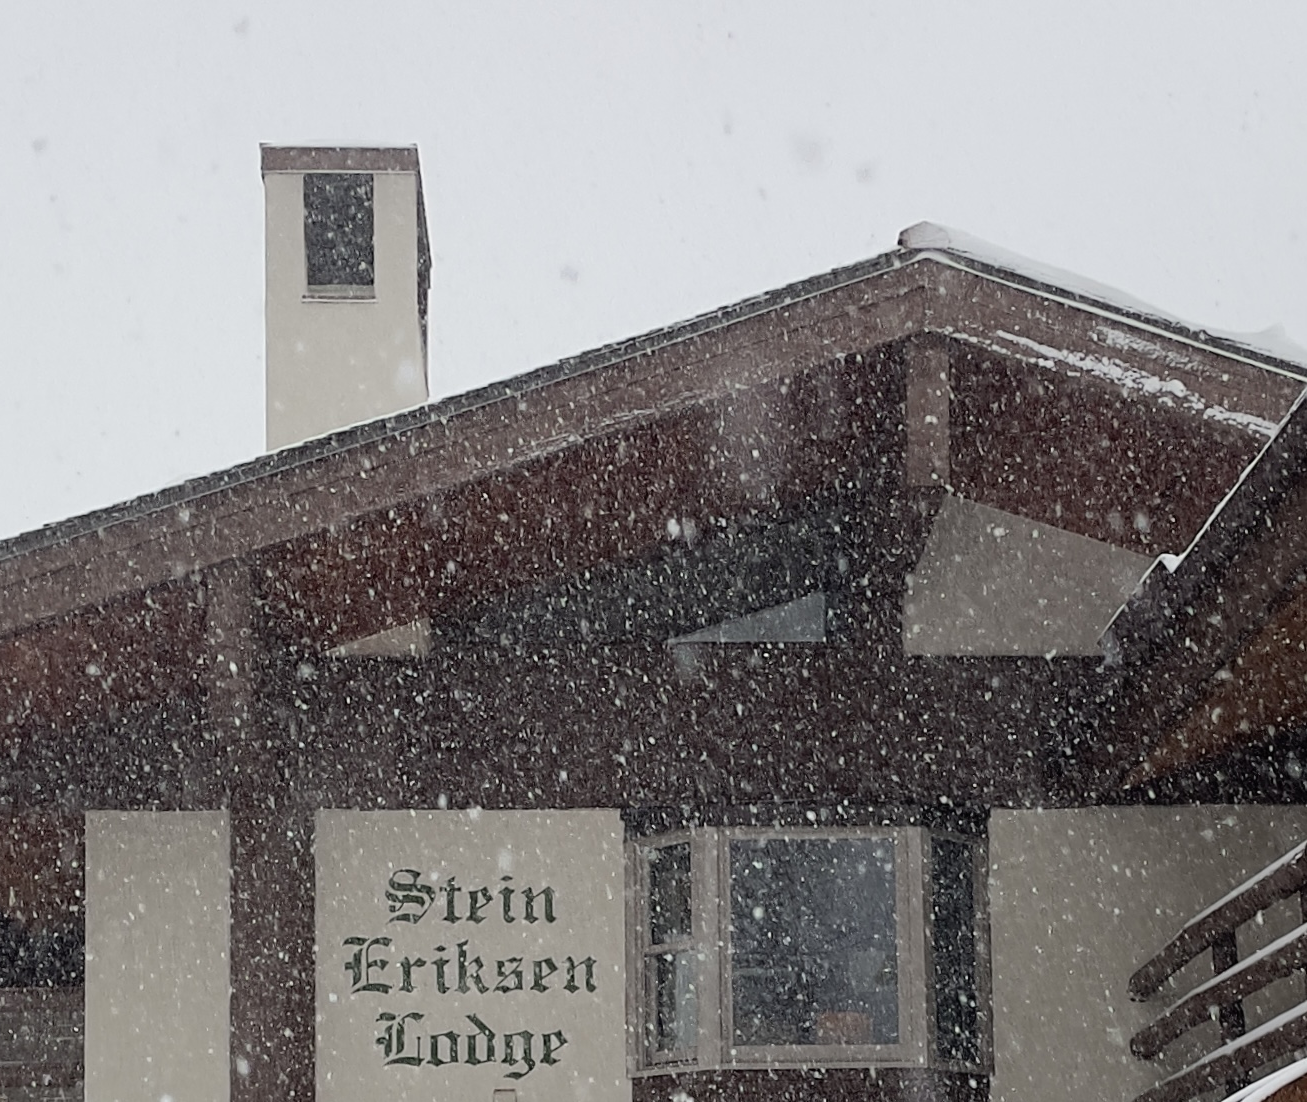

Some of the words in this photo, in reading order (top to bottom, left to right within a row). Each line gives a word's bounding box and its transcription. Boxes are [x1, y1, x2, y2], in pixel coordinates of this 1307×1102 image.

[385, 869, 557, 925] Stein
[343, 936, 597, 994] Eriksen
[375, 1012, 568, 1080] Lodge
